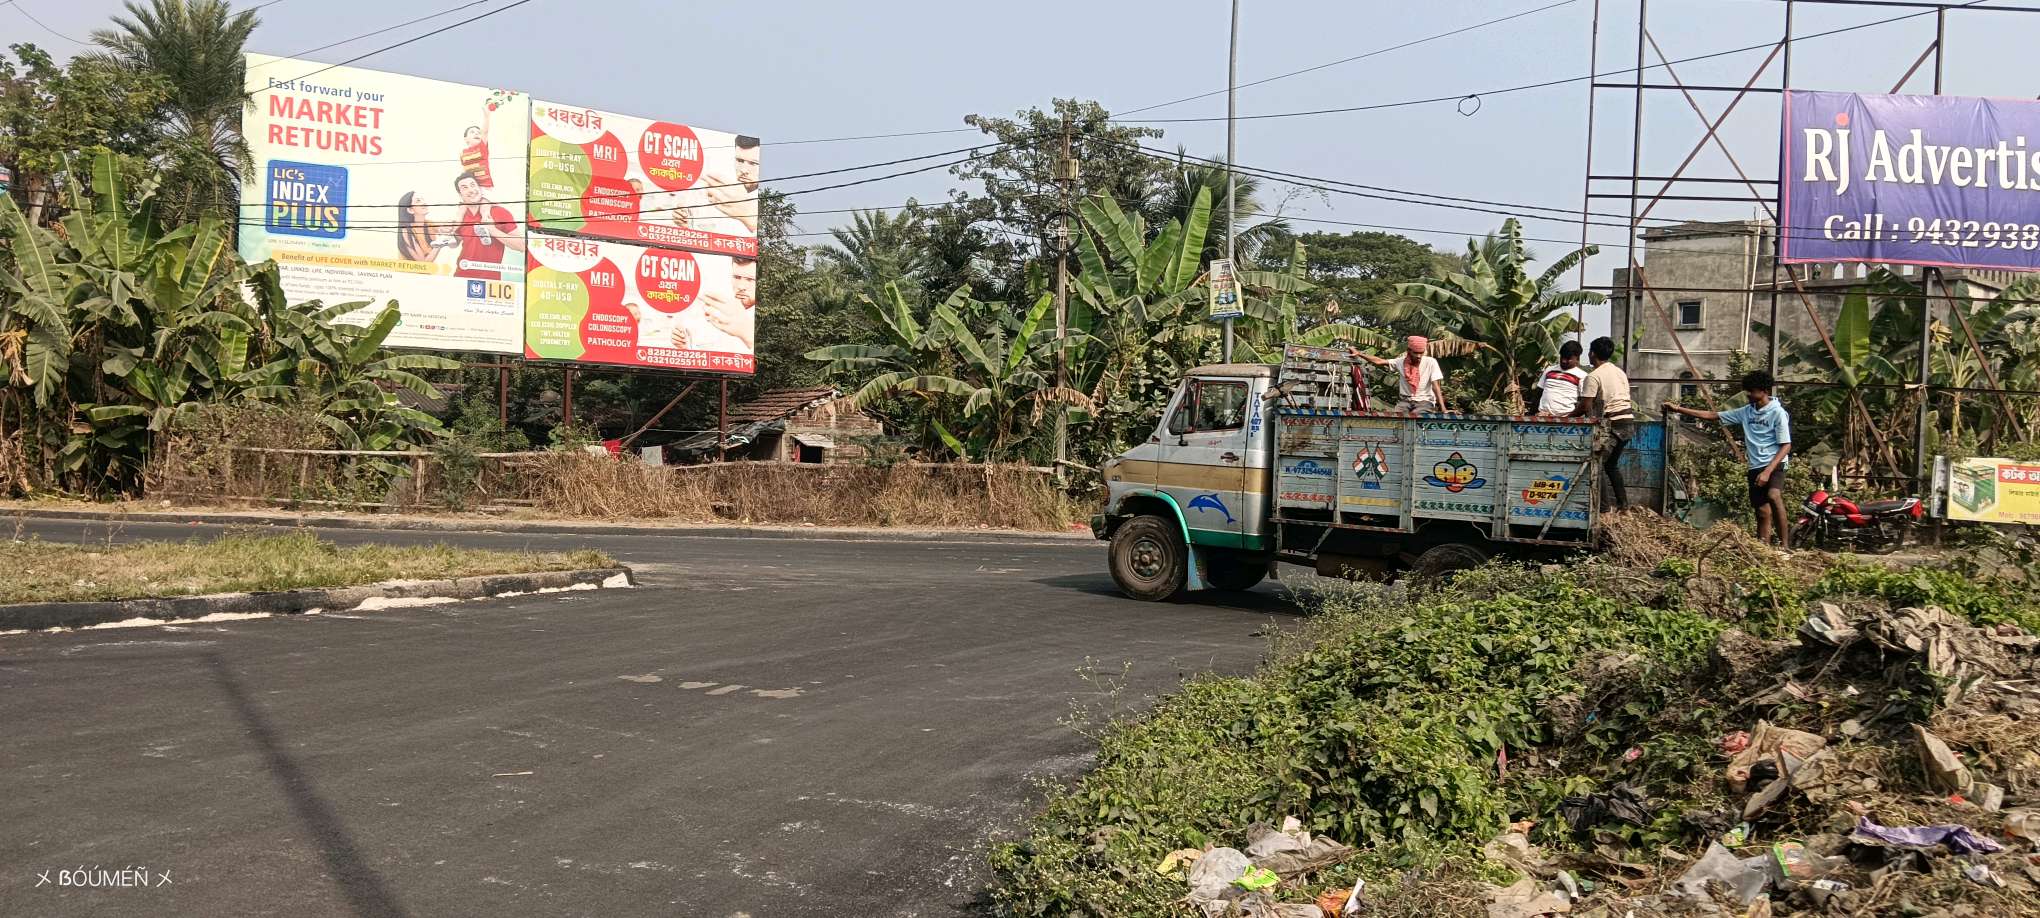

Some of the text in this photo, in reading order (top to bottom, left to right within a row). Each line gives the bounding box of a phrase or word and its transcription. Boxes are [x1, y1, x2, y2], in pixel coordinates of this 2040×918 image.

[268, 77, 385, 102] Fast forward your
[268, 94, 385, 129] MARKET
[268, 123, 383, 156] RETURNS
[644, 130, 698, 161] CT SCAN
[593, 144, 617, 160] MRI
[274, 168, 305, 181] LIC's
[273, 180, 329, 204] INDEX
[272, 200, 340, 233] PLUS
[1823, 213, 1884, 242] Call
[281, 252, 305, 261] Benefit
[330, 256, 352, 265] COVER
[370, 260, 397, 268] MARKET
[398, 262, 427, 270] RETURNS
[641, 254, 695, 282] CT SCAN
[590, 271, 615, 286] MRI
[489, 283, 512, 299] LIC
[588, 323, 632, 334] COLONOSCOPY
[592, 313, 628, 323] ENDOSCOPY
[587, 337, 631, 348] PATHOLOGY
